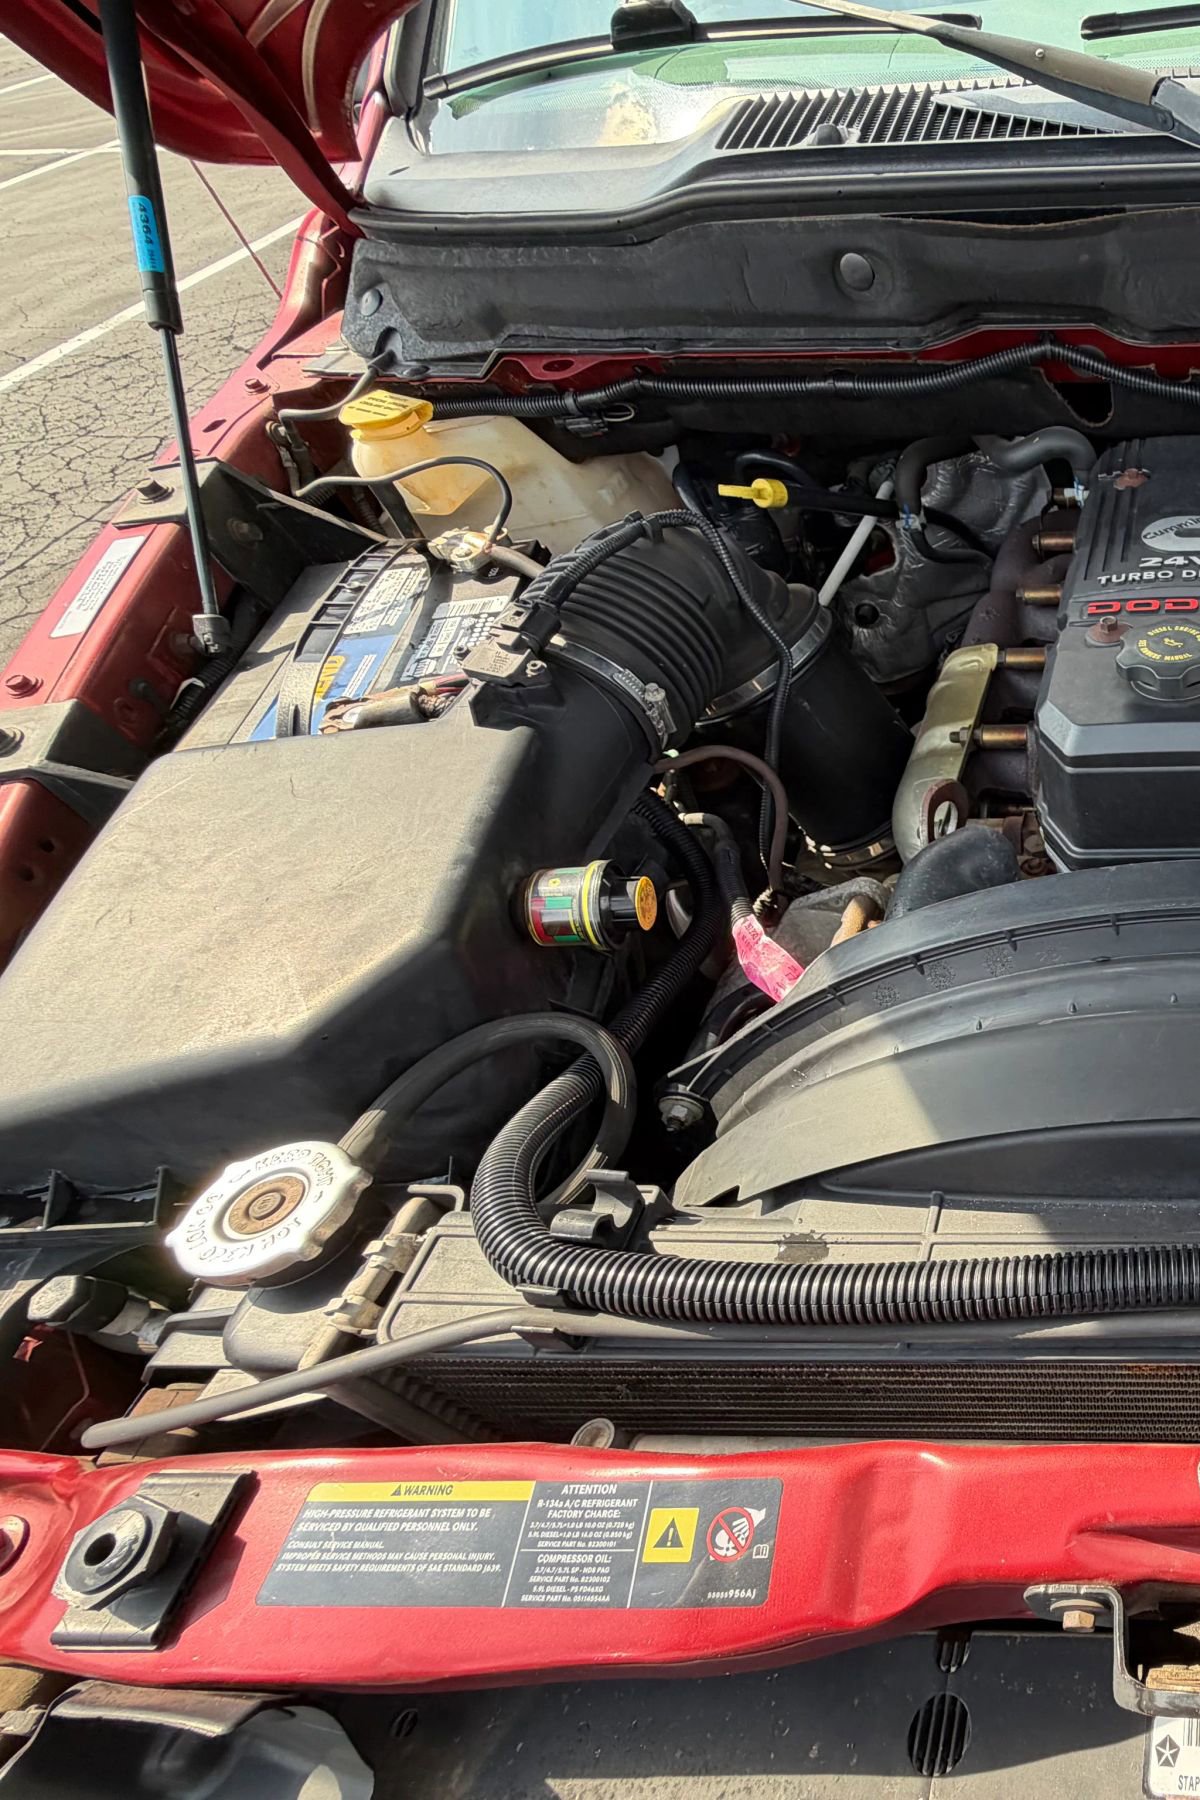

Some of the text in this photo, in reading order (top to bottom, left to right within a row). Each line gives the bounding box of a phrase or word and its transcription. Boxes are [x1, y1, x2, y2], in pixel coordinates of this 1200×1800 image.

[1097, 570, 1175, 585] TURBO
[404, 1484, 454, 1497] WARNING
[561, 1484, 618, 1495] ATTENTION
[563, 1499, 580, 1509] A/C
[580, 1499, 638, 1509] REFRIGERANT
[302, 1508, 492, 1519] HIGH-PRESSURE REFRIGERANT SYSTEM TO BE
[547, 1509, 621, 1519] FACTORY CHARGE:
[296, 1521, 479, 1532] SERVICED BY QUALIFIED PERSONNEL ONLY.
[287, 1540, 385, 1550] CONSULT SERVICE MANUAL.
[537, 1540, 561, 1548] SERVICE
[560, 1540, 575, 1548] PART
[282, 1551, 495, 1561] IMPROPER SERVICE METHODS MAY CAUSE PERSONAL INJURY.
[537, 1553, 612, 1563] COMPRESSOR OIL:
[276, 1563, 307, 1573] SYSTEM
[307, 1563, 331, 1573] MEETS
[332, 1563, 359, 1573] SAFETY
[359, 1563, 415, 1573] REQUIREMENTS
[416, 1563, 426, 1573] OF
[427, 1563, 442, 1573] SAE
[443, 1563, 483, 1573] STANDARD
[545, 1585, 567, 1593] DIESEL
[521, 1594, 546, 1602] SERVICE
[546, 1594, 562, 1602] PART
[1178, 1775, 1200, 1792] STAP
